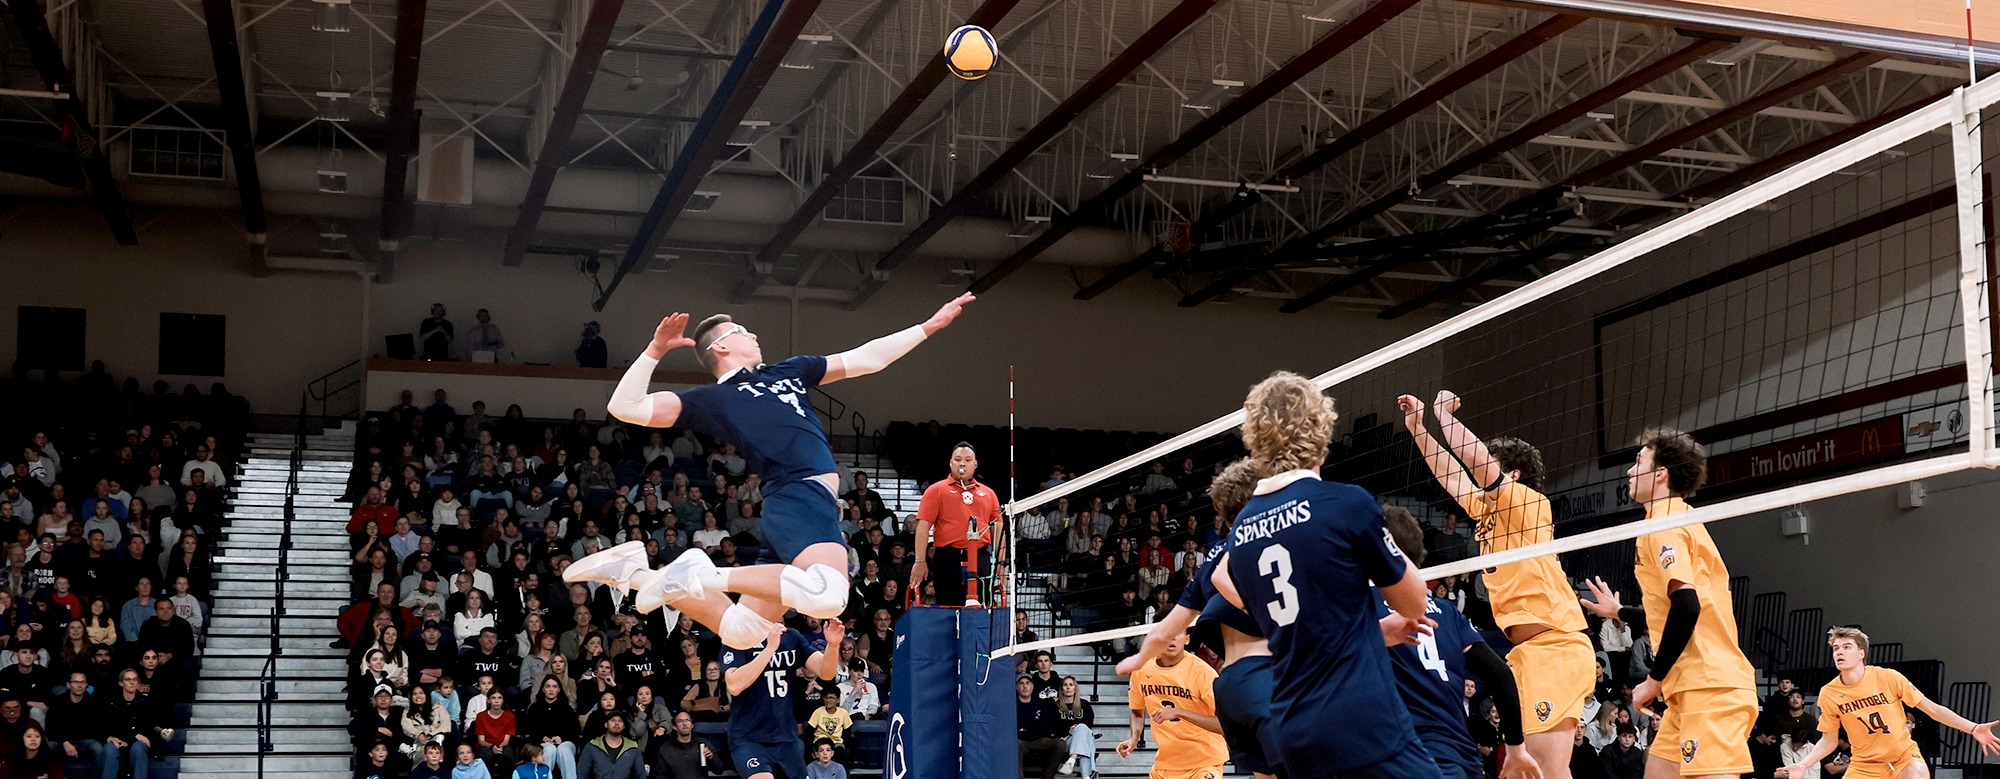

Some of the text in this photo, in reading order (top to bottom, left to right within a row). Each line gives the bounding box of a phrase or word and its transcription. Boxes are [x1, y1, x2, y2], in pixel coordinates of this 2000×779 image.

[777, 392, 806, 417] 7
[1751, 439, 1836, 477] i'm lovin' it
[1243, 499, 1297, 525] TRINITY WESTERN
[1572, 491, 1605, 511] COUNTRY
[1235, 500, 1312, 546] SPARTANS
[1258, 543, 1300, 627] 3
[1416, 623, 1449, 681] 4
[475, 662, 499, 672] TWU
[626, 662, 652, 672] TWU
[764, 670, 789, 698] 15
[1140, 684, 1194, 701] MANITOBA
[1837, 692, 1890, 715] MANITOBA
[1856, 711, 1891, 735] 14
